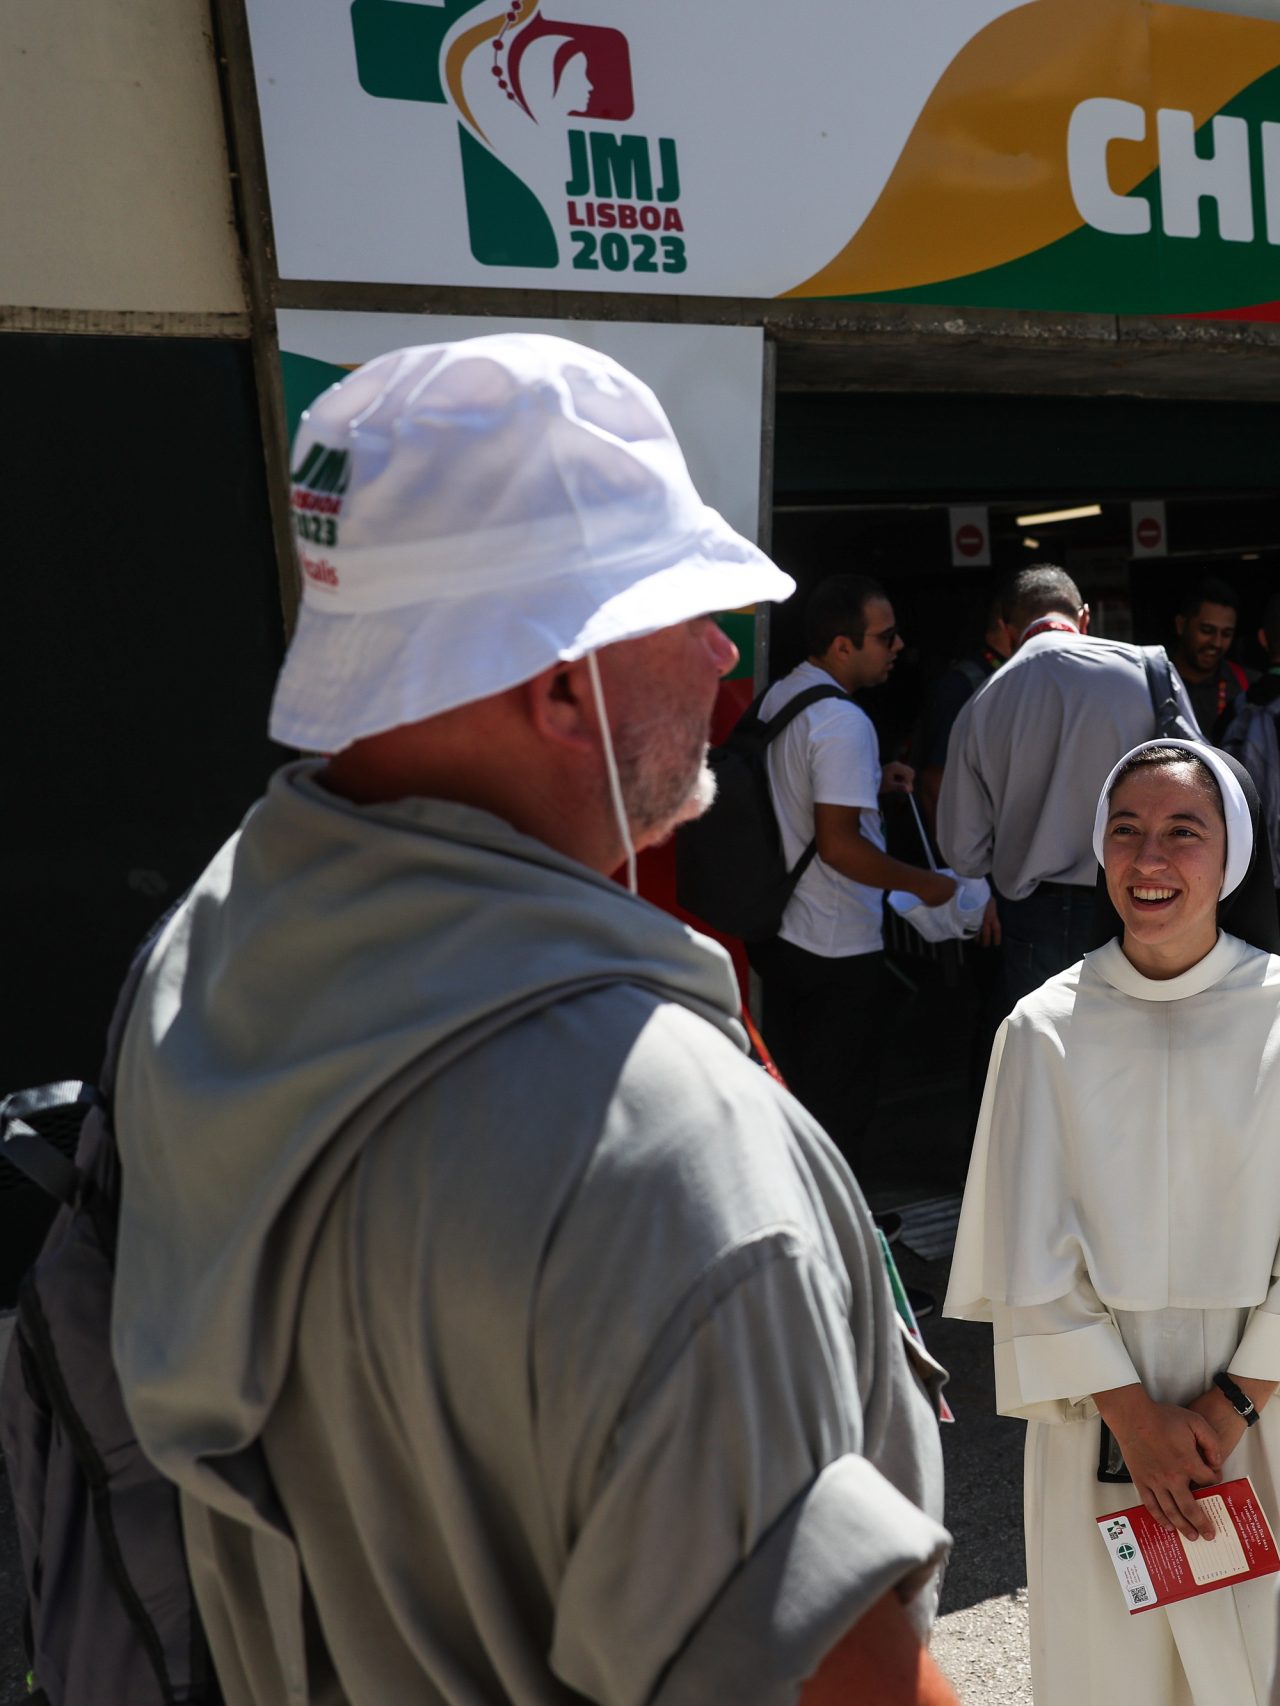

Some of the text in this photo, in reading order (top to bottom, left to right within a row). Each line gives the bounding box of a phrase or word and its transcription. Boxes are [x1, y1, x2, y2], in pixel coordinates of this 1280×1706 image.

[565, 129, 681, 202] JMJ
[567, 201, 685, 232] LISBOA
[570, 231, 687, 273] 2023
